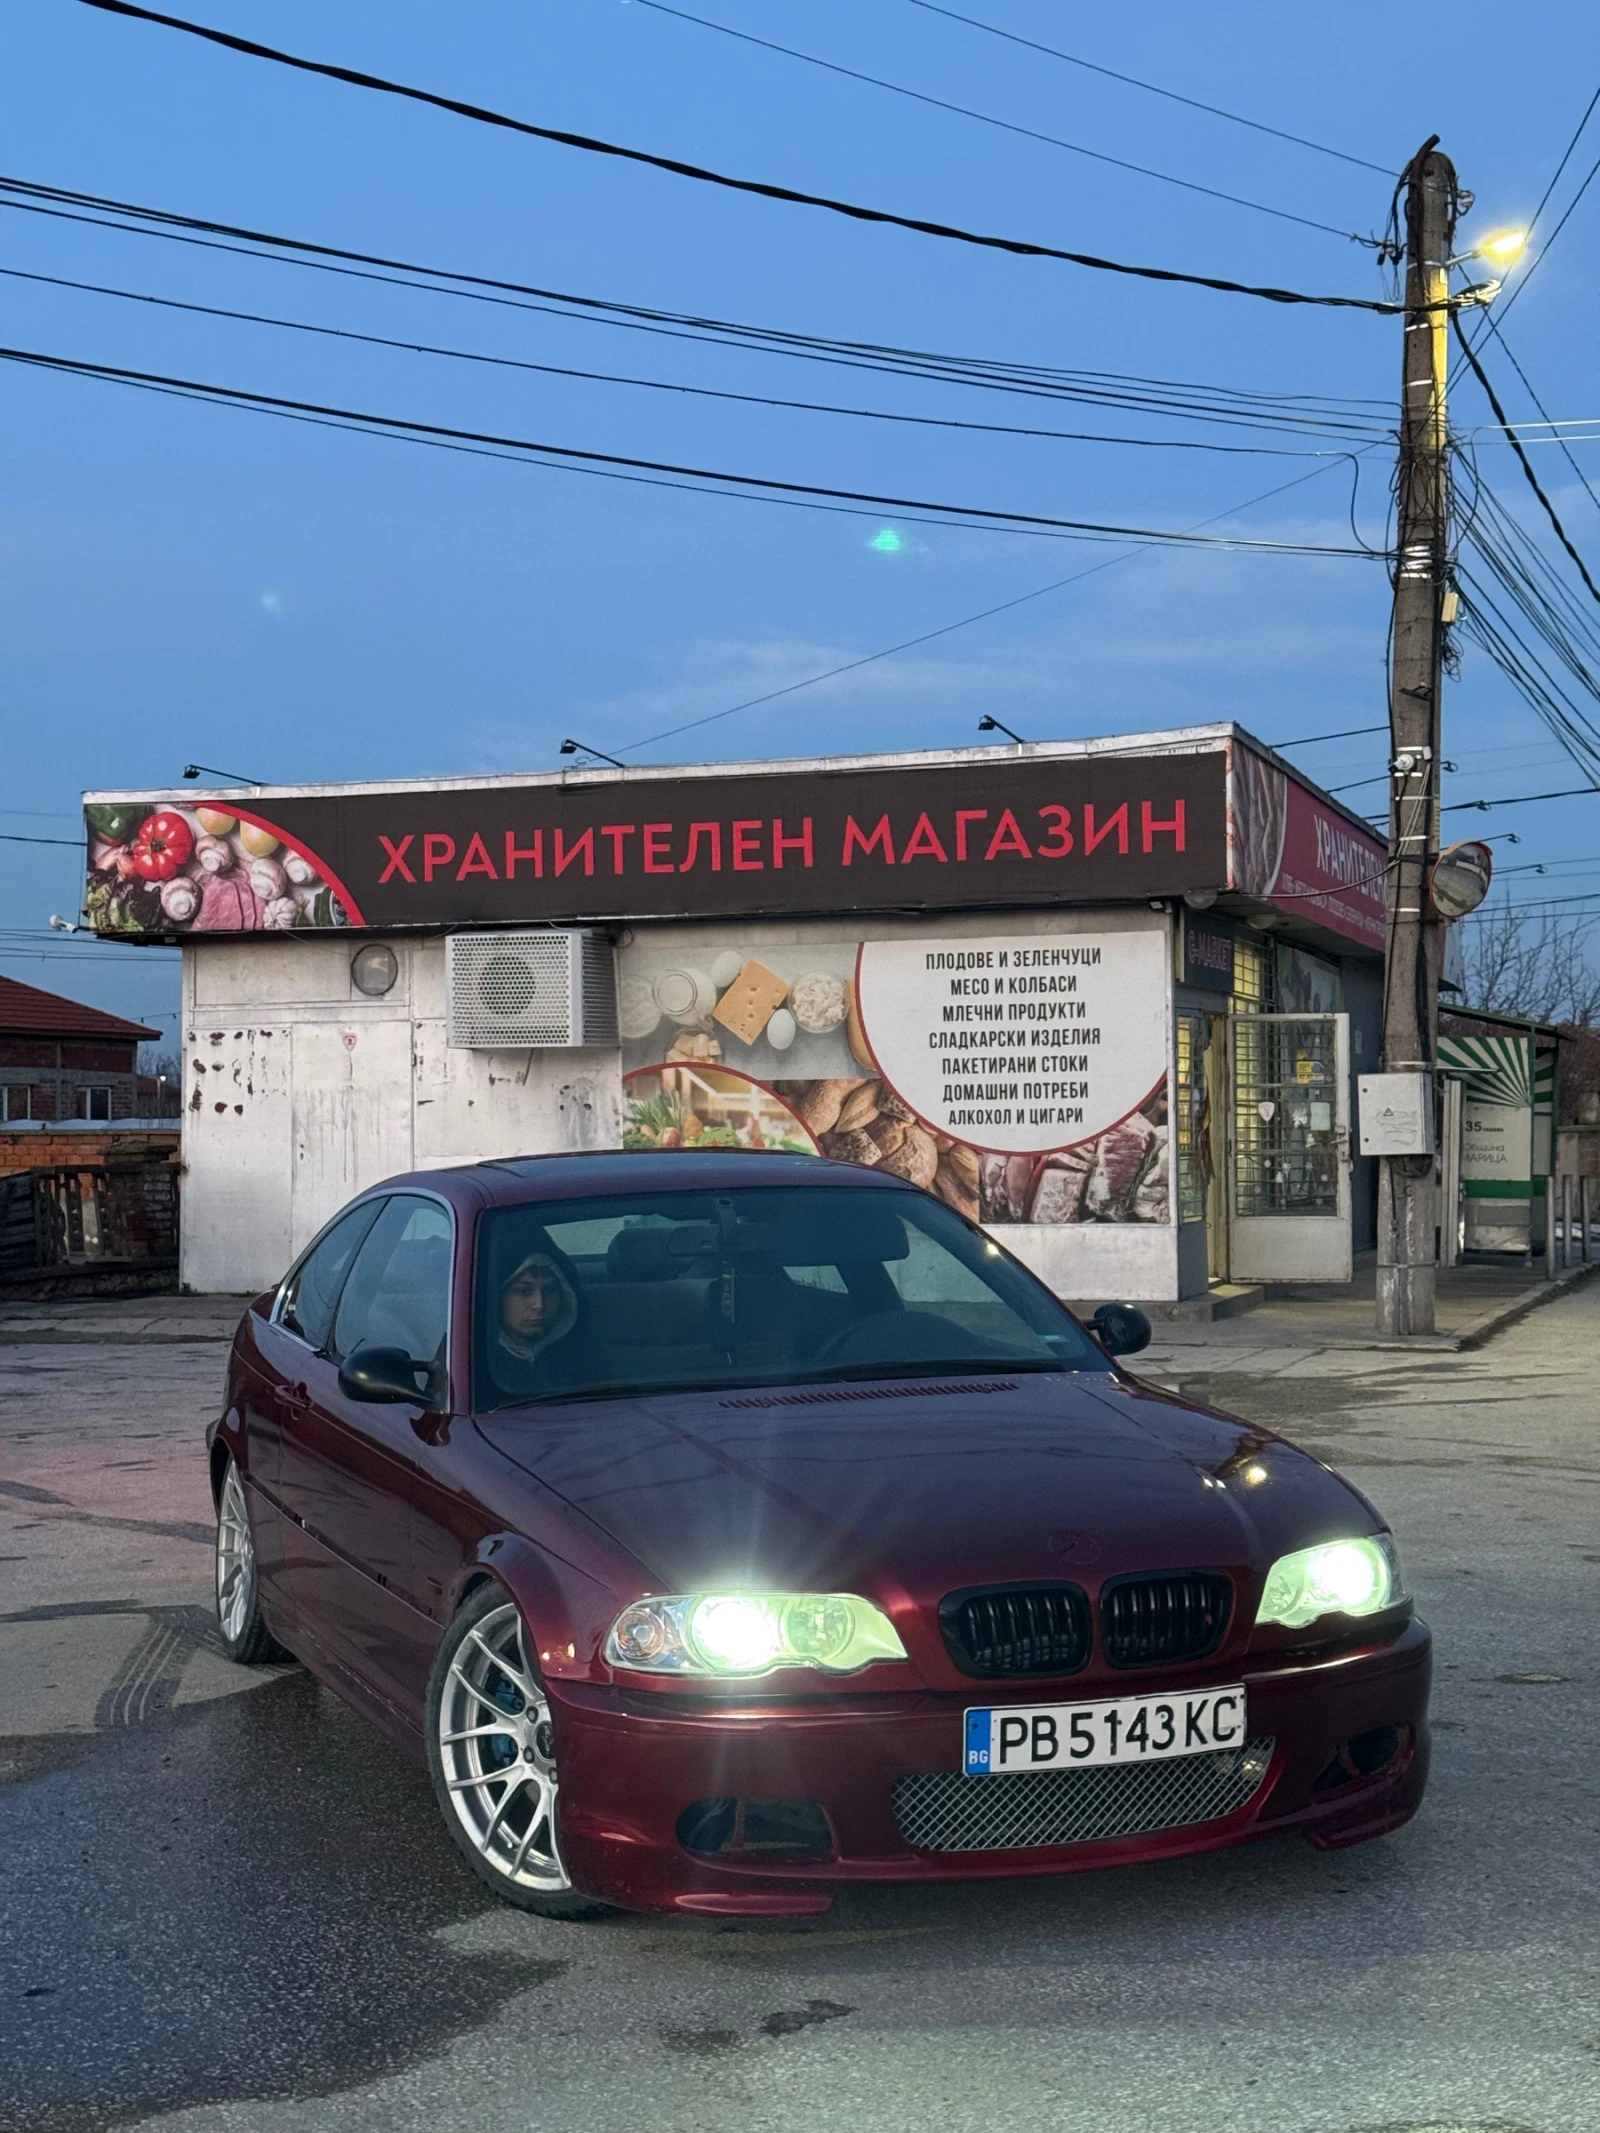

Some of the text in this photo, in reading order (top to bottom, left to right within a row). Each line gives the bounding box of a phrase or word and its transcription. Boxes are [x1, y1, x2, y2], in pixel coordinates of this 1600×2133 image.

[378, 799, 1186, 884] ХРАНИТЕЛЕН МАГАЗИН
[925, 947, 1101, 971] ПЛОДОВЕ И ЗЕЛЕНЧУЦИ
[950, 975, 1077, 996] МЕСО И КОЛБАСИ
[942, 1001, 1086, 1022] МЛЕЧНИ ПРОДУКТИ
[929, 1027, 1101, 1050] СЛАДКАРСКИ ИЗДЕЛИЯ
[942, 1054, 1088, 1075] ПАКЕТИРАНИ СТОКИ
[942, 1081, 1089, 1102] ДОМАШНИ ПОТРЕБИ
[948, 1107, 1083, 1126] АЛКОХОЛ И ЦИГАРИ
[1465, 1120, 1482, 1132] 35
[968, 1749, 989, 1764] BG
